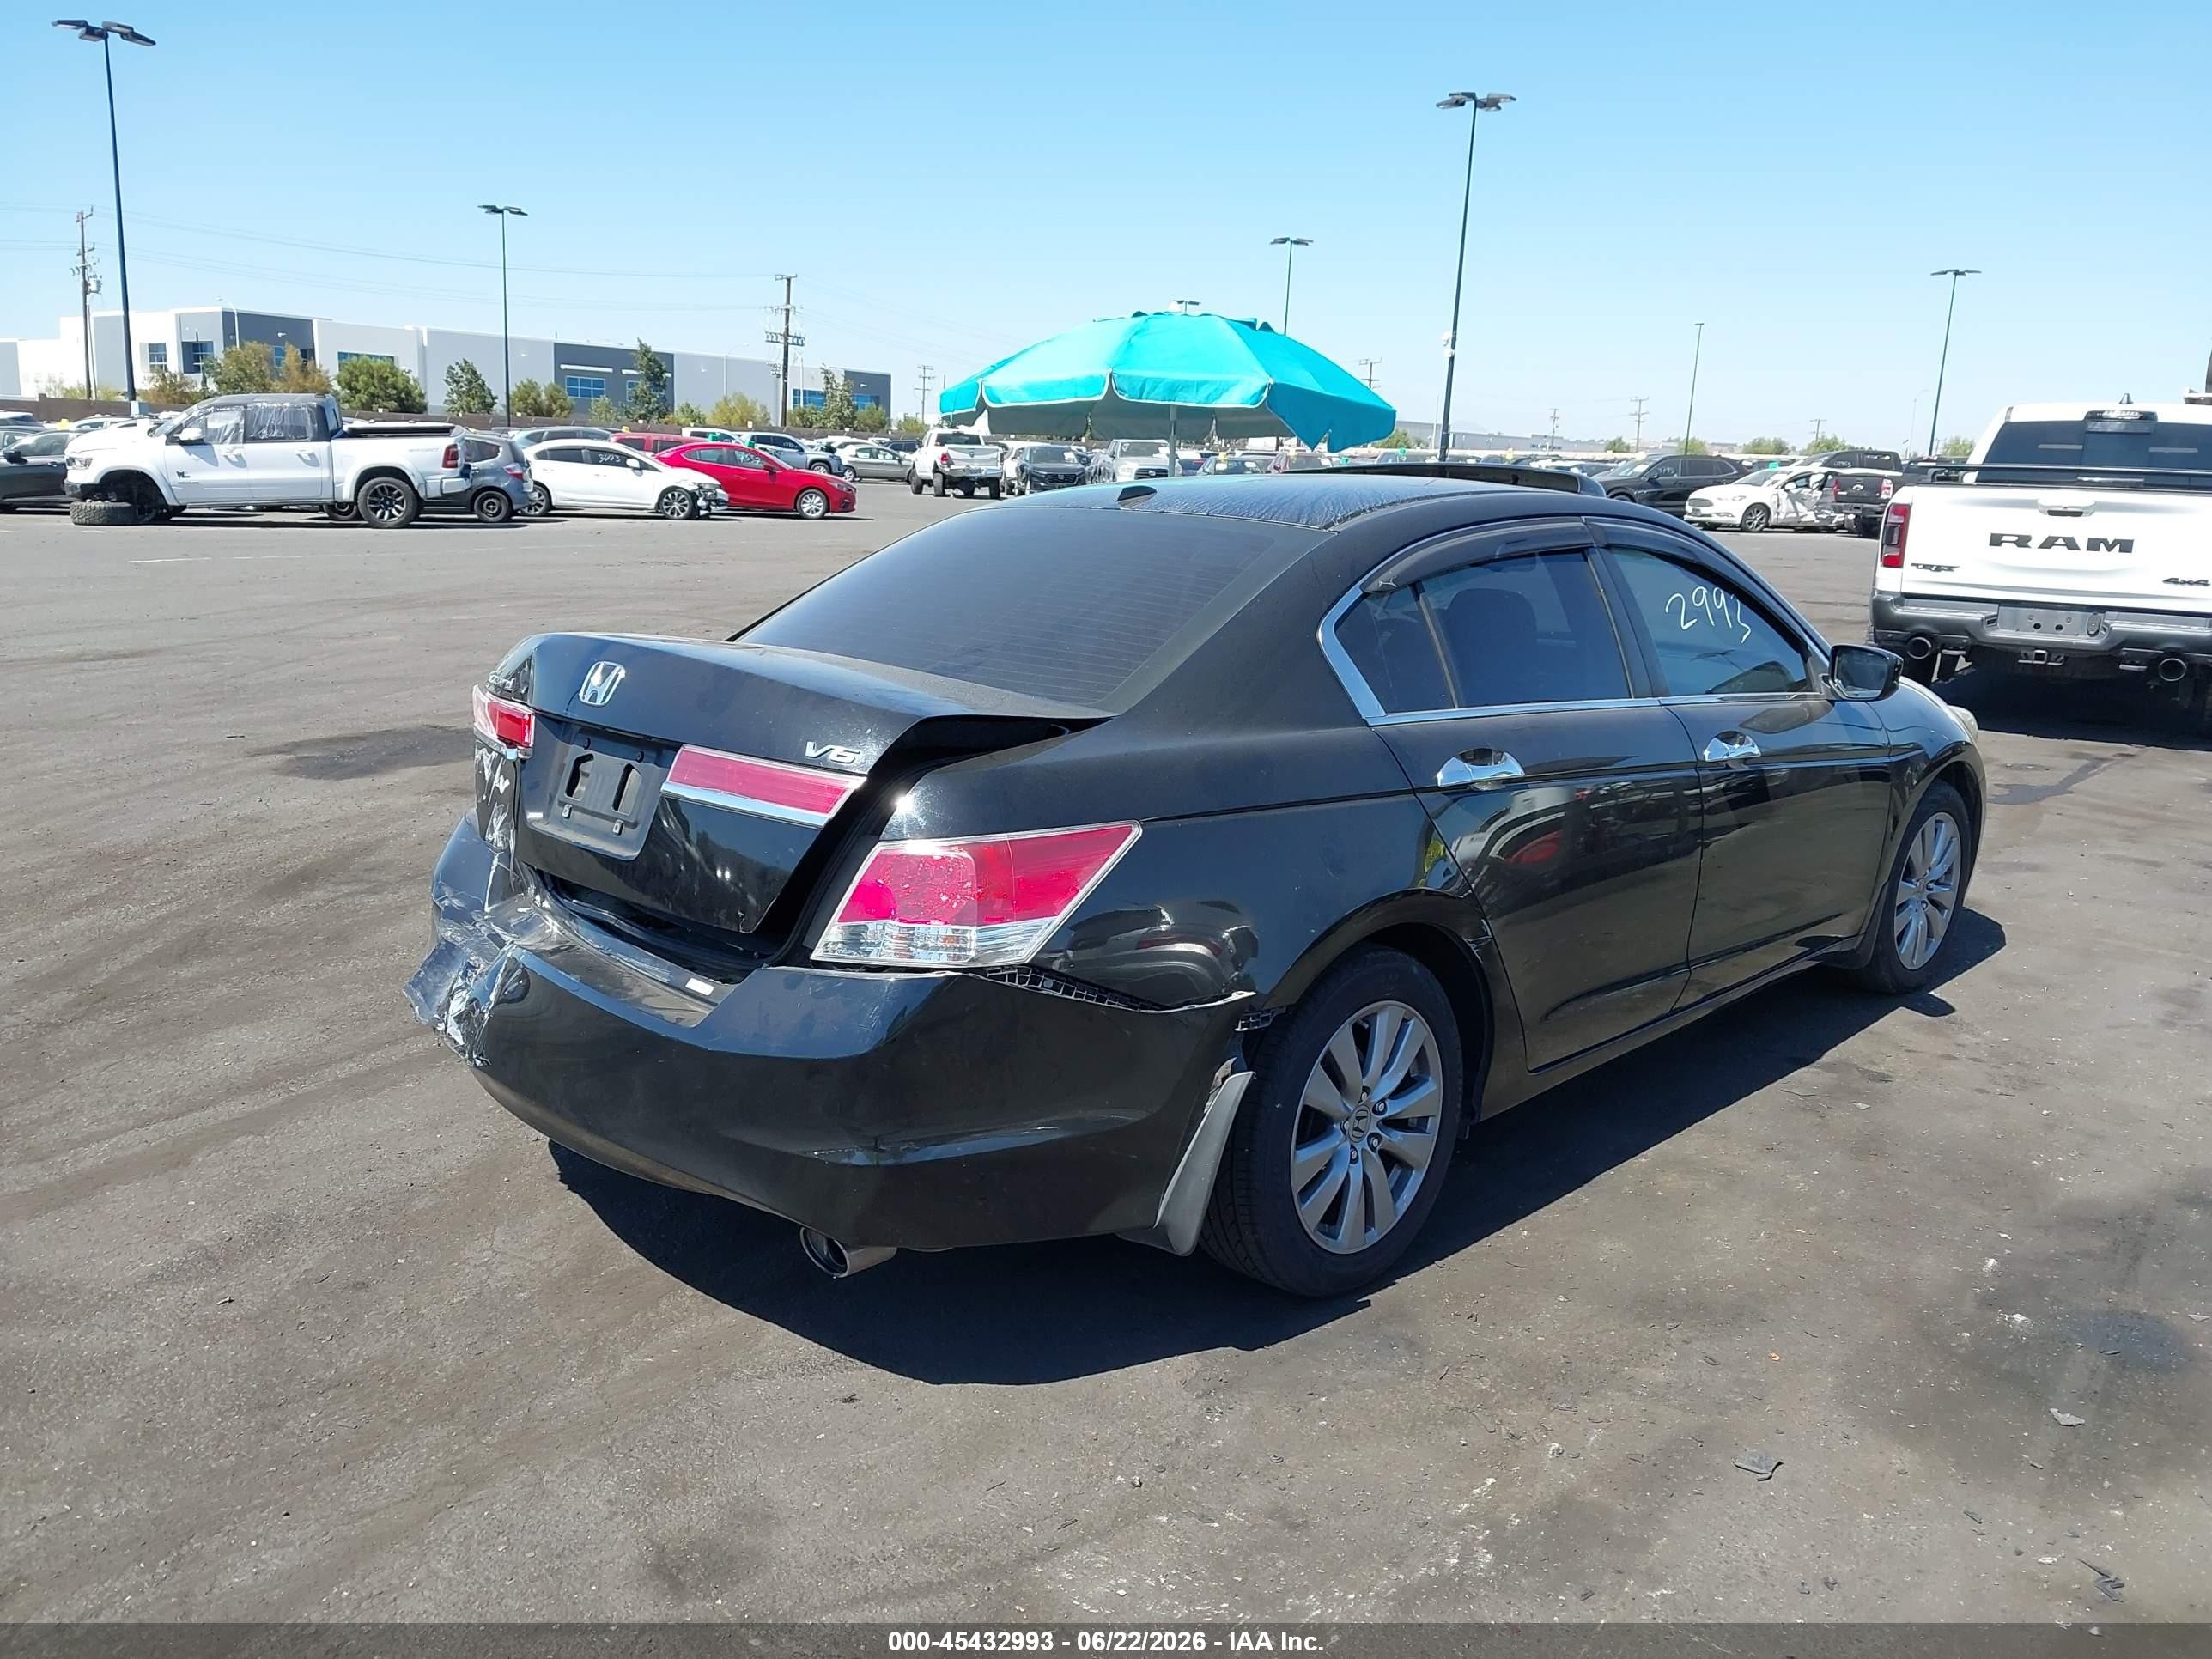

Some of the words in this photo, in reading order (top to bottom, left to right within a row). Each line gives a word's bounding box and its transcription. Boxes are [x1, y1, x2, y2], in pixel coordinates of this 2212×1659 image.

[1989, 532, 2135, 553] RAM
[1665, 586, 1752, 643] 2993
[805, 741, 861, 763] V6
